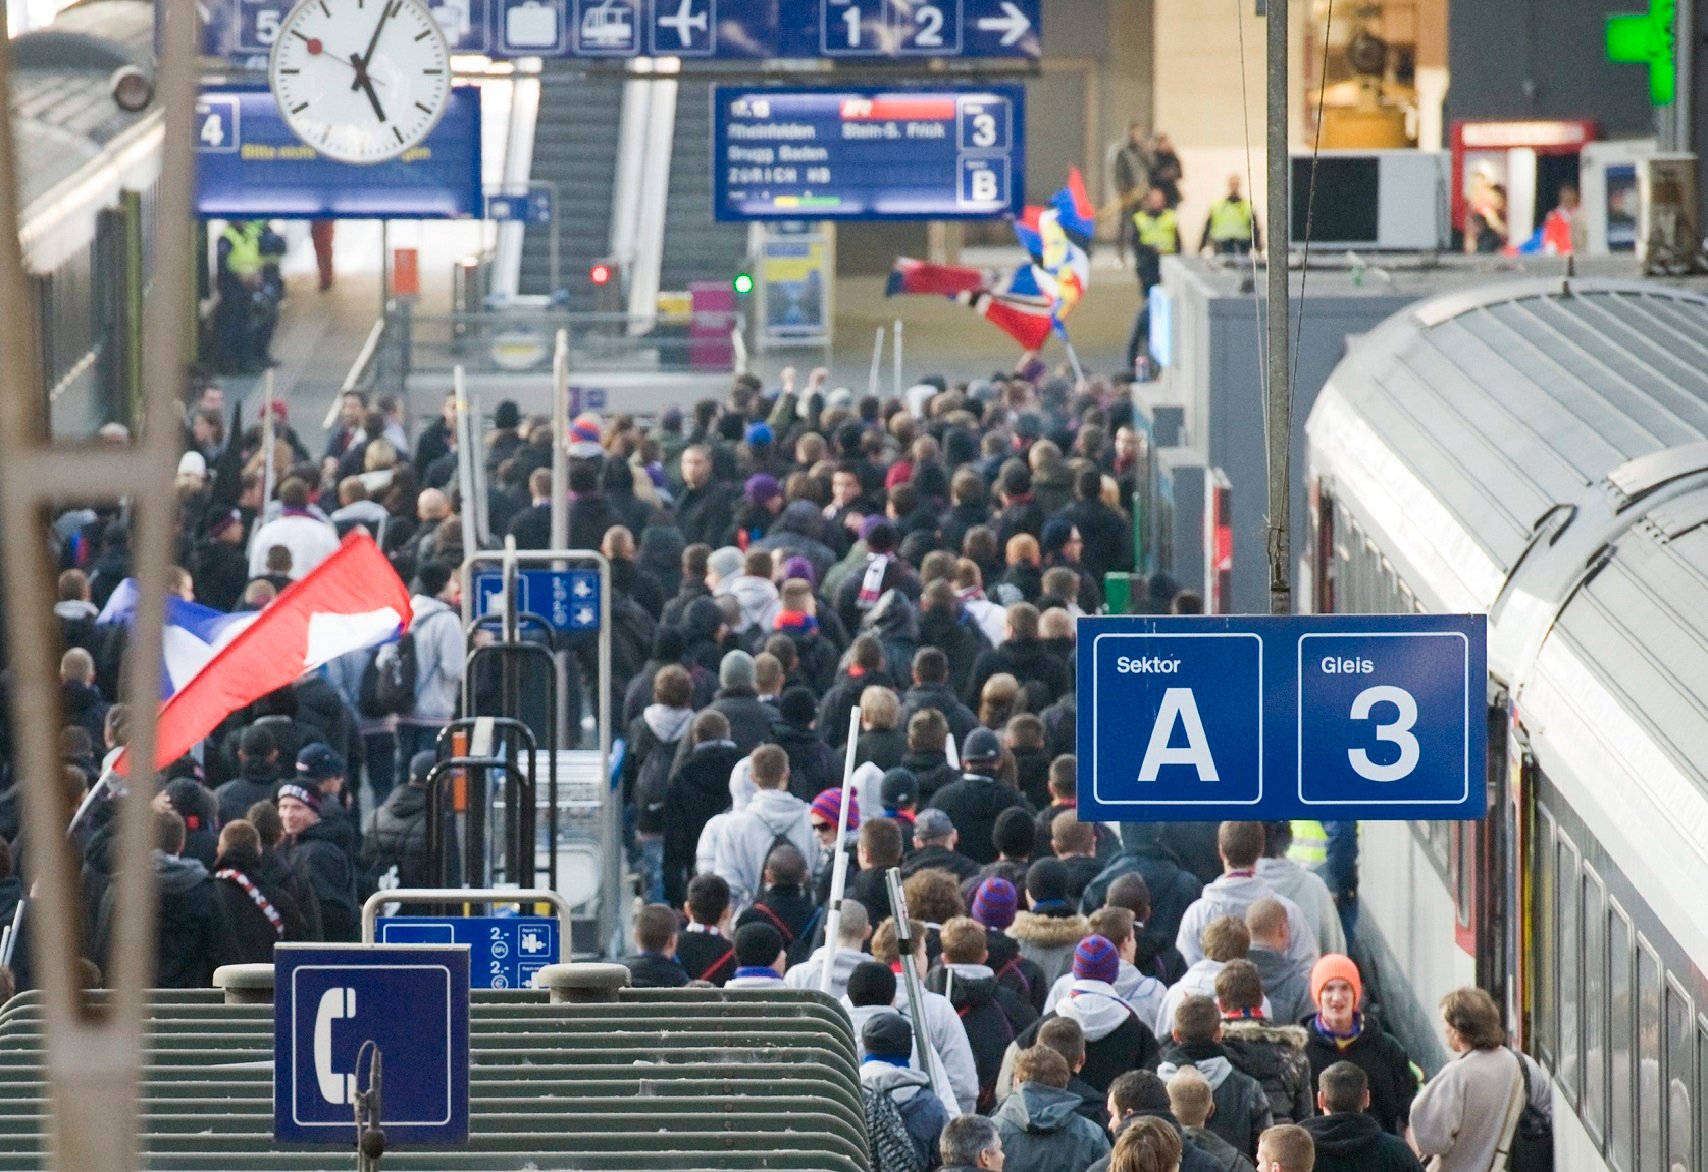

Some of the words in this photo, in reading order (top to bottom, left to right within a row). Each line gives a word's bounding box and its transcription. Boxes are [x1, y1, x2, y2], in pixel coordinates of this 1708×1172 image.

[256, 9, 282, 44] 5
[841, 6, 861, 48] 1
[915, 5, 944, 47] 2
[201, 113, 225, 147] 4
[972, 113, 997, 147] 3
[971, 169, 998, 201] B
[1116, 656, 1181, 674] Sektor
[1321, 656, 1374, 674] Gleis
[1137, 687, 1221, 782] A
[1347, 685, 1420, 782] 3
